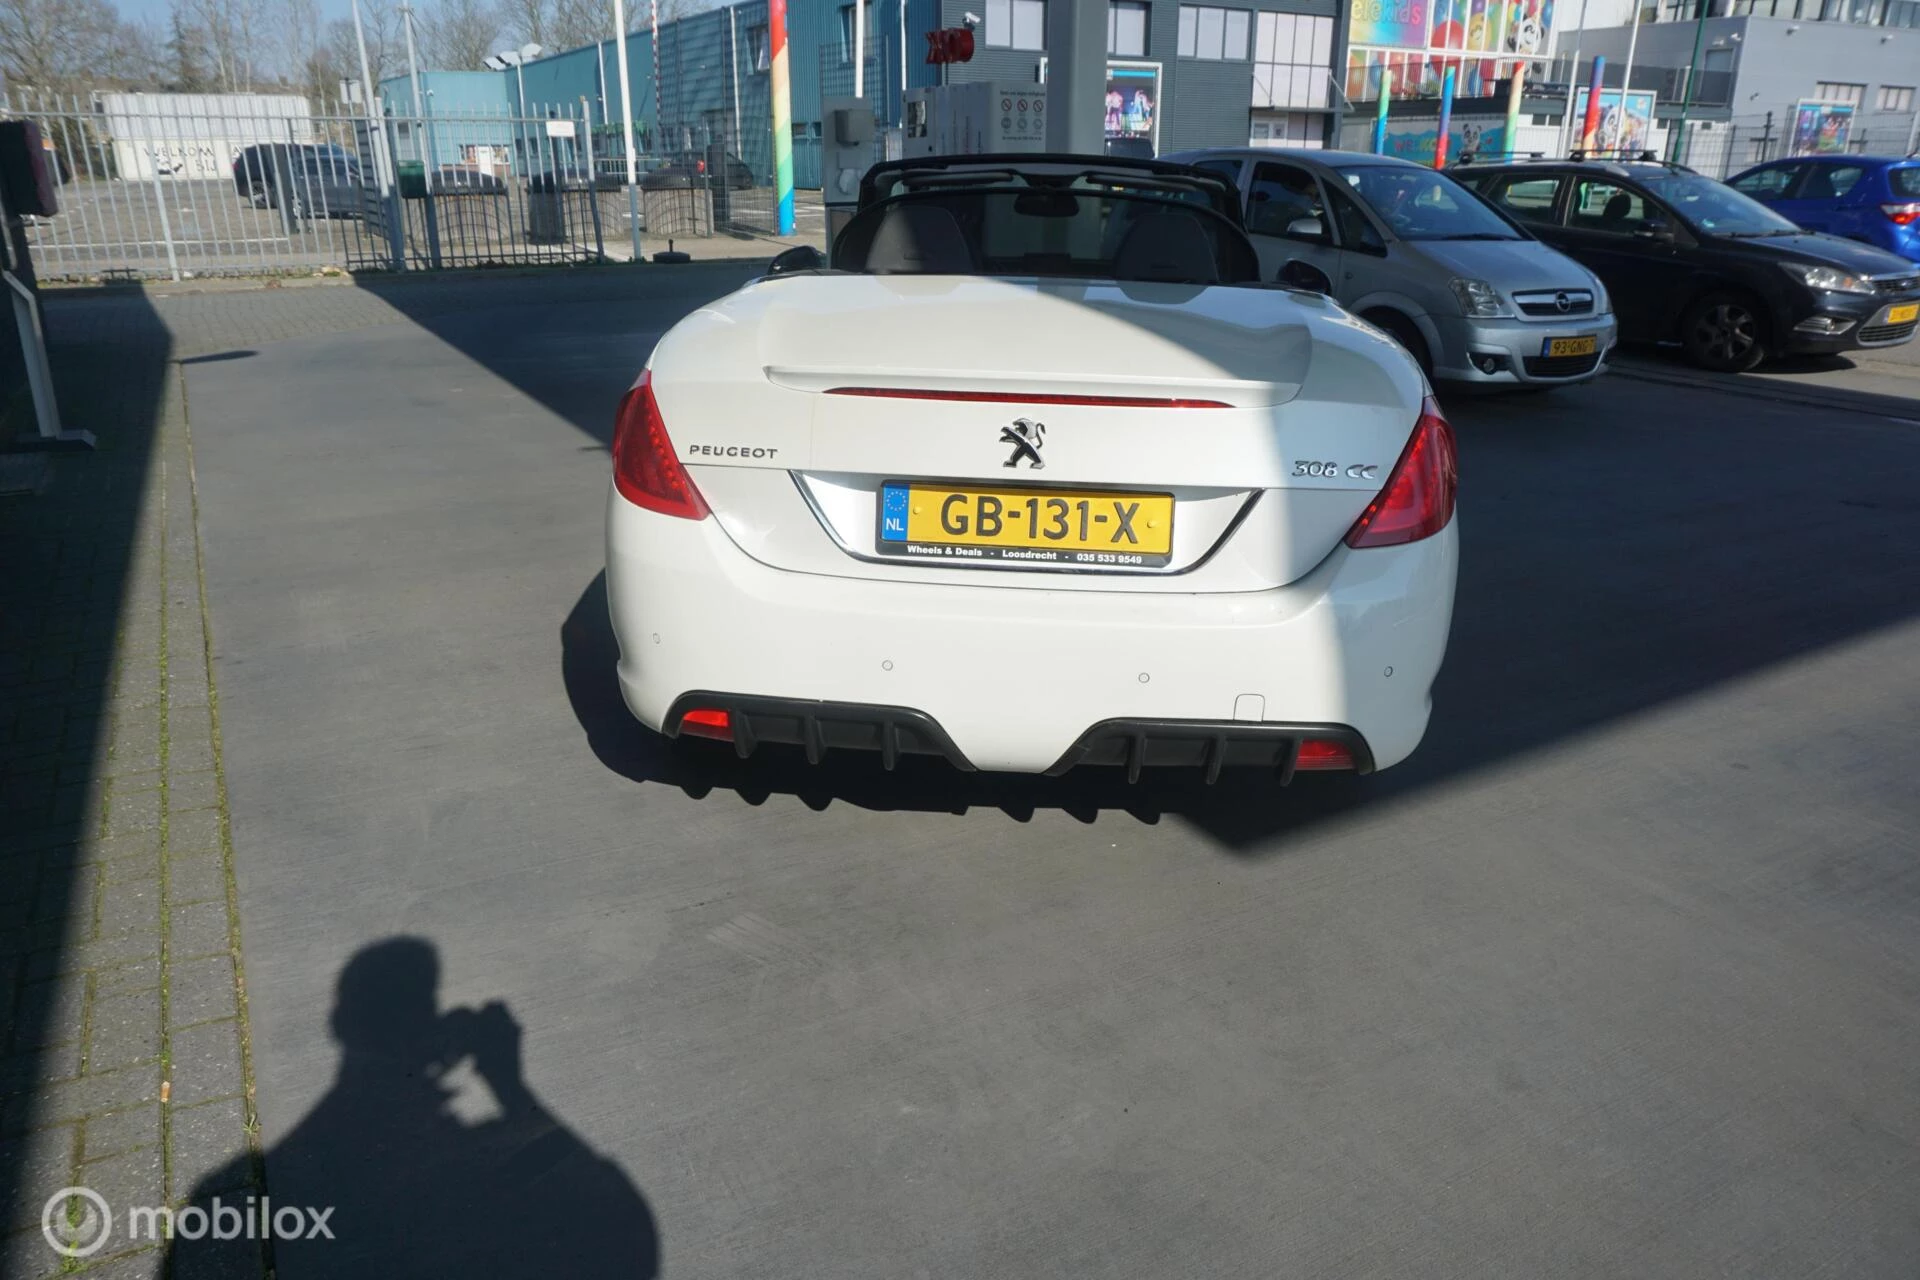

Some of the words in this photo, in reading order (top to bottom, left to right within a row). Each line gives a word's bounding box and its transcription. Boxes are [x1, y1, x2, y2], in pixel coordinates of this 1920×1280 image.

[689, 444, 778, 459] PEUGEOT
[1292, 460, 1338, 478] 308
[886, 517, 904, 532] NL
[940, 493, 1140, 544] GB-131-X
[907, 545, 942, 555] Wheels
[945, 546, 953, 555] &
[955, 547, 982, 556] Deals
[1002, 549, 1057, 560] Loosdrecht
[1077, 553, 1095, 561] 035
[1118, 556, 1142, 564] 9549
